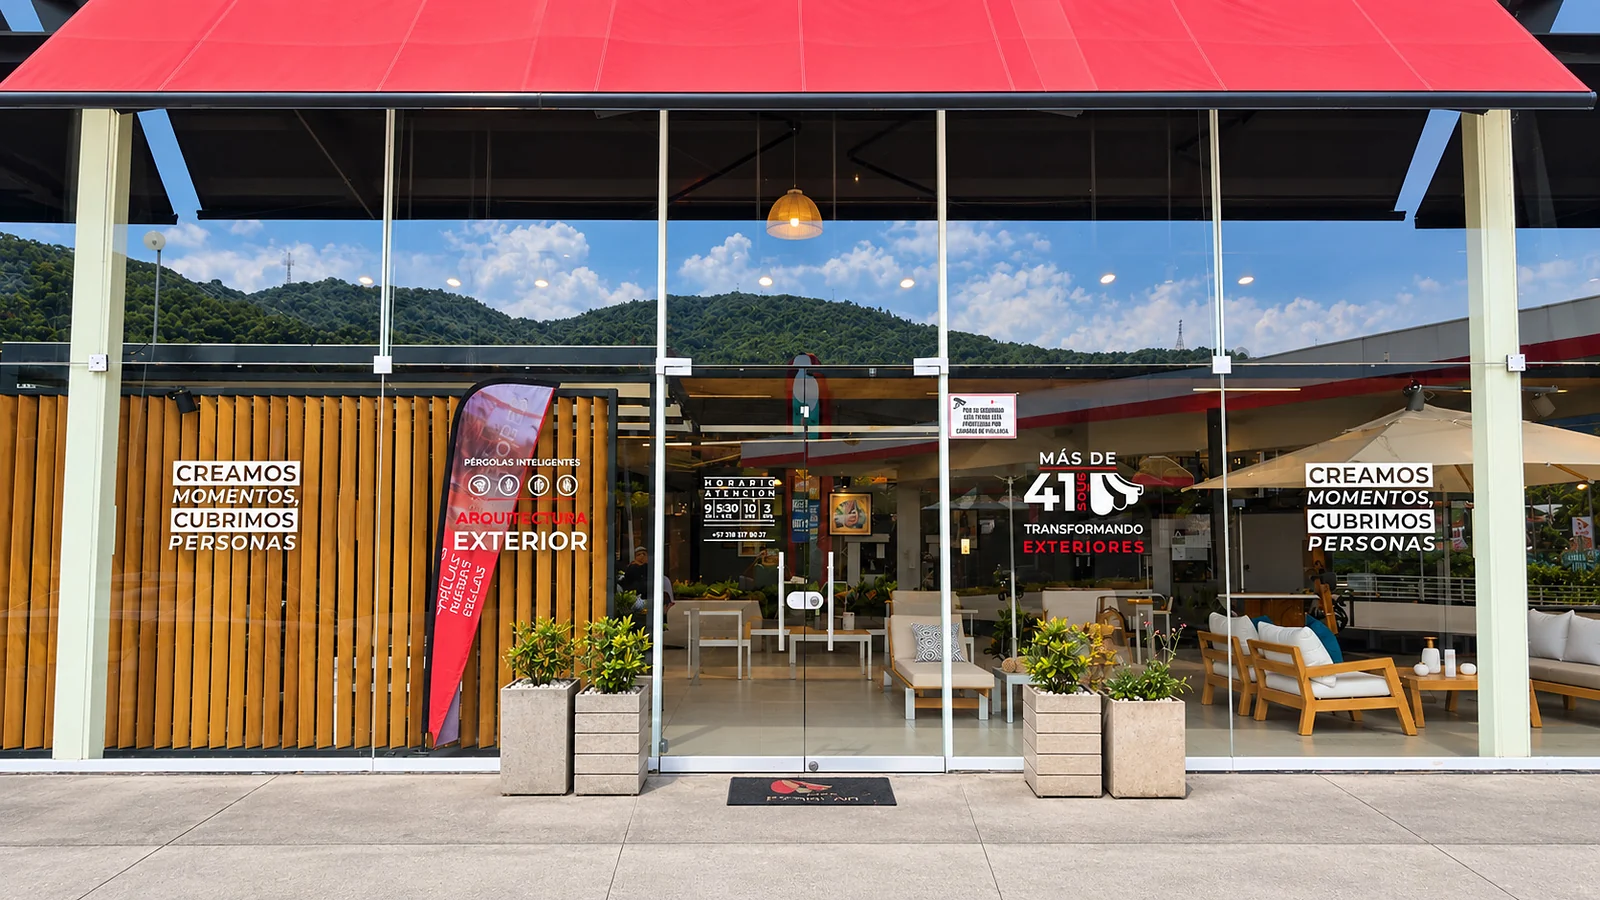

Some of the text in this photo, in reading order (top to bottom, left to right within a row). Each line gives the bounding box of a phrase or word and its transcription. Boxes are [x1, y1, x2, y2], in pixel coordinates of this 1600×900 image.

[464, 457, 581, 467] PÉRGOLAS INTELIGENTES
[1039, 448, 1117, 465] MÁS DE
[176, 465, 296, 482] CREAMOS
[1309, 467, 1429, 484] CREAMOS
[704, 479, 775, 487] HORARIO
[172, 488, 299, 507] MOMENTOS,
[1023, 472, 1076, 512] 41
[1307, 490, 1434, 508] MOMENTOS,
[704, 503, 712, 514] 9
[743, 503, 757, 513] 10
[763, 503, 771, 513] 3
[174, 512, 294, 528] CUBRIMOS
[455, 512, 588, 525] ARQUITECTURA
[1310, 513, 1432, 529] CUBRIMOS
[1023, 524, 1144, 535] TRANSFORMANDO
[168, 535, 296, 550] PERSONAS
[453, 531, 588, 551] EXTERIOR
[1023, 540, 1145, 553] EXTERIORES
[1308, 536, 1435, 551] PERSONAS
